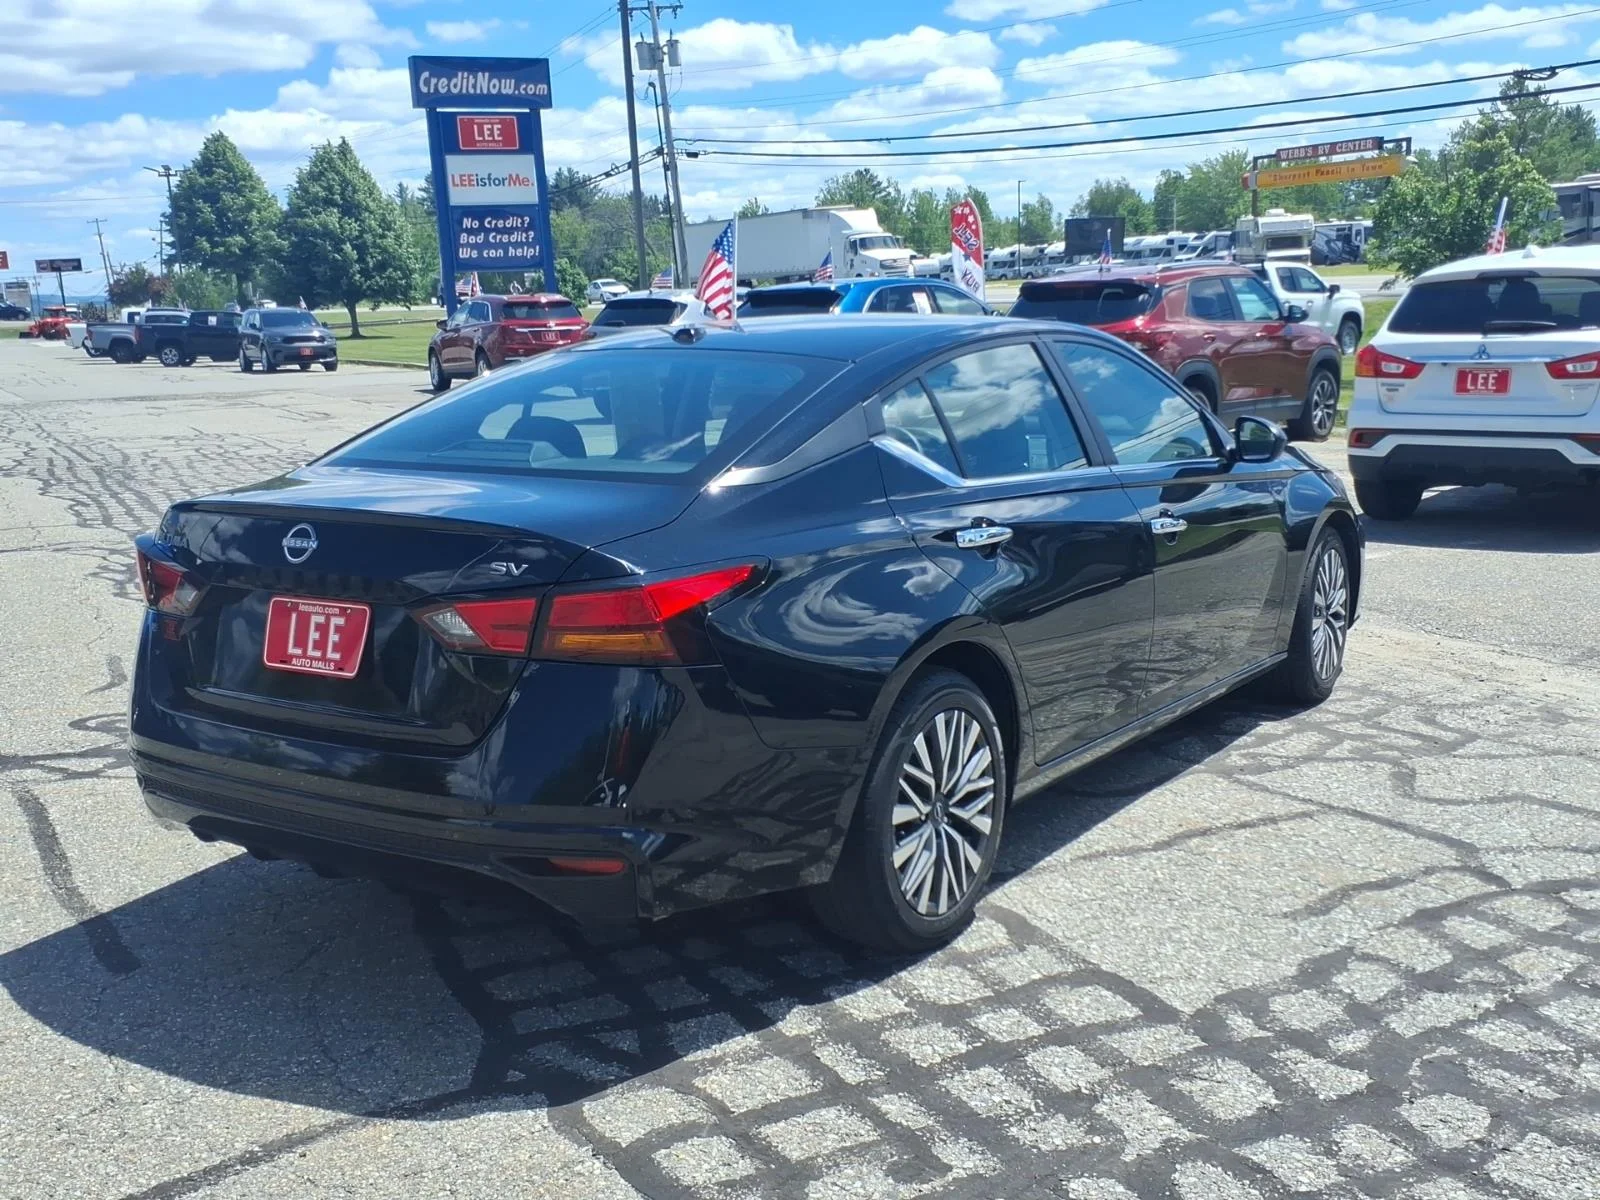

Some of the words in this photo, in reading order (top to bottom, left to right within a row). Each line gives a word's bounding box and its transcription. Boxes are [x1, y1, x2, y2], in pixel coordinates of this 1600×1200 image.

[419, 71, 548, 95] CreditNow.com
[473, 124, 503, 140] LEE
[1280, 147, 1312, 160] WEBB'S
[1318, 144, 1330, 154] RV
[1336, 139, 1373, 153] CENTER
[451, 172, 535, 188] LEEisforMe.
[463, 217, 479, 229] No
[484, 216, 530, 229] Credit?
[460, 232, 484, 244] Bad
[488, 231, 535, 243] Credit?
[459, 247, 478, 258] We
[483, 249, 504, 258] can
[508, 245, 539, 259] help!
[1467, 373, 1498, 389] LEE
[489, 561, 529, 576] SV
[298, 603, 340, 614] leeauto.com
[287, 612, 346, 660] LEE
[291, 658, 311, 667] AUTO
[312, 659, 335, 670] MALLS
